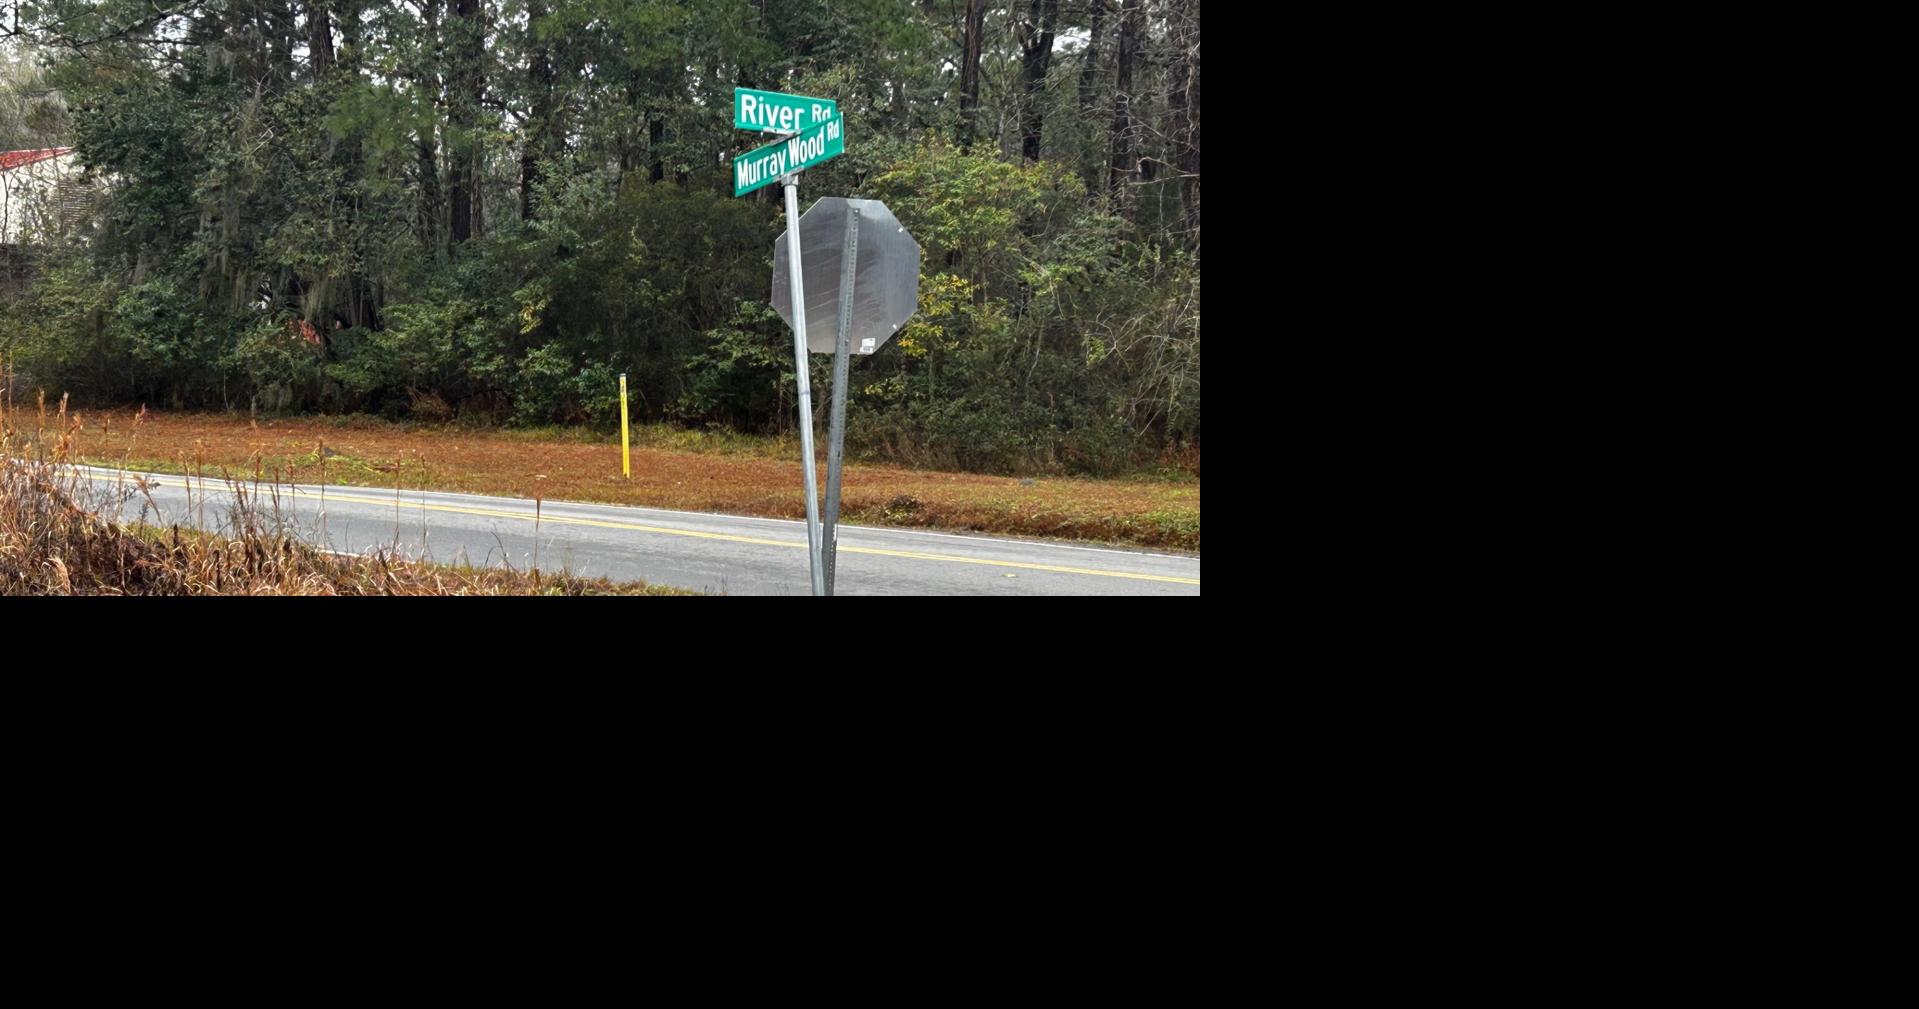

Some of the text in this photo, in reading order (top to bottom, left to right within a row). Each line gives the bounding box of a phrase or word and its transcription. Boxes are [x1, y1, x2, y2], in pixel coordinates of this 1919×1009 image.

[741, 94, 831, 129] River Rd
[737, 118, 840, 190] Murray Wood Rd
